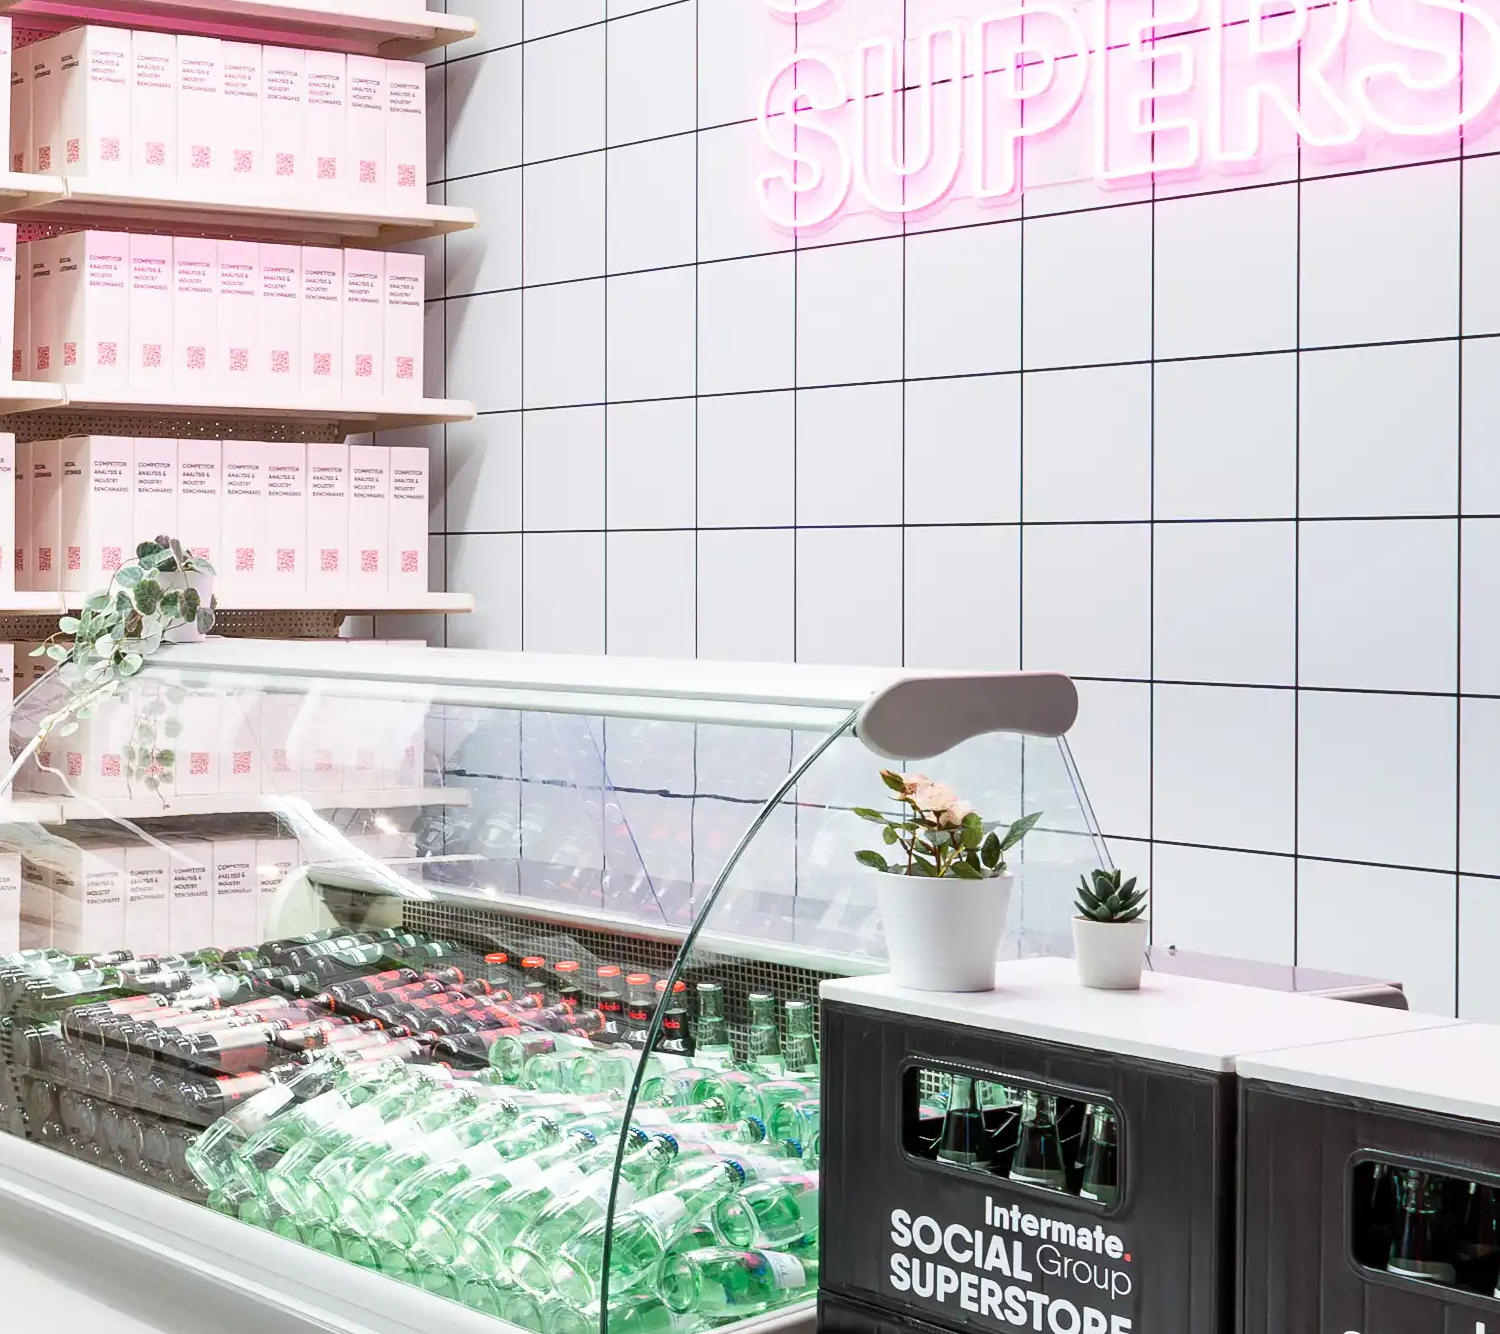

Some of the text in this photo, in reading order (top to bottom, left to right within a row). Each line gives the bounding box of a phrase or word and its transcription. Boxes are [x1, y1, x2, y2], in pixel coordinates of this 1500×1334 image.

[891, 1209, 1032, 1282] SOCIAL
[986, 1196, 1131, 1262] Intermate.
[1037, 1244, 1131, 1300] Group
